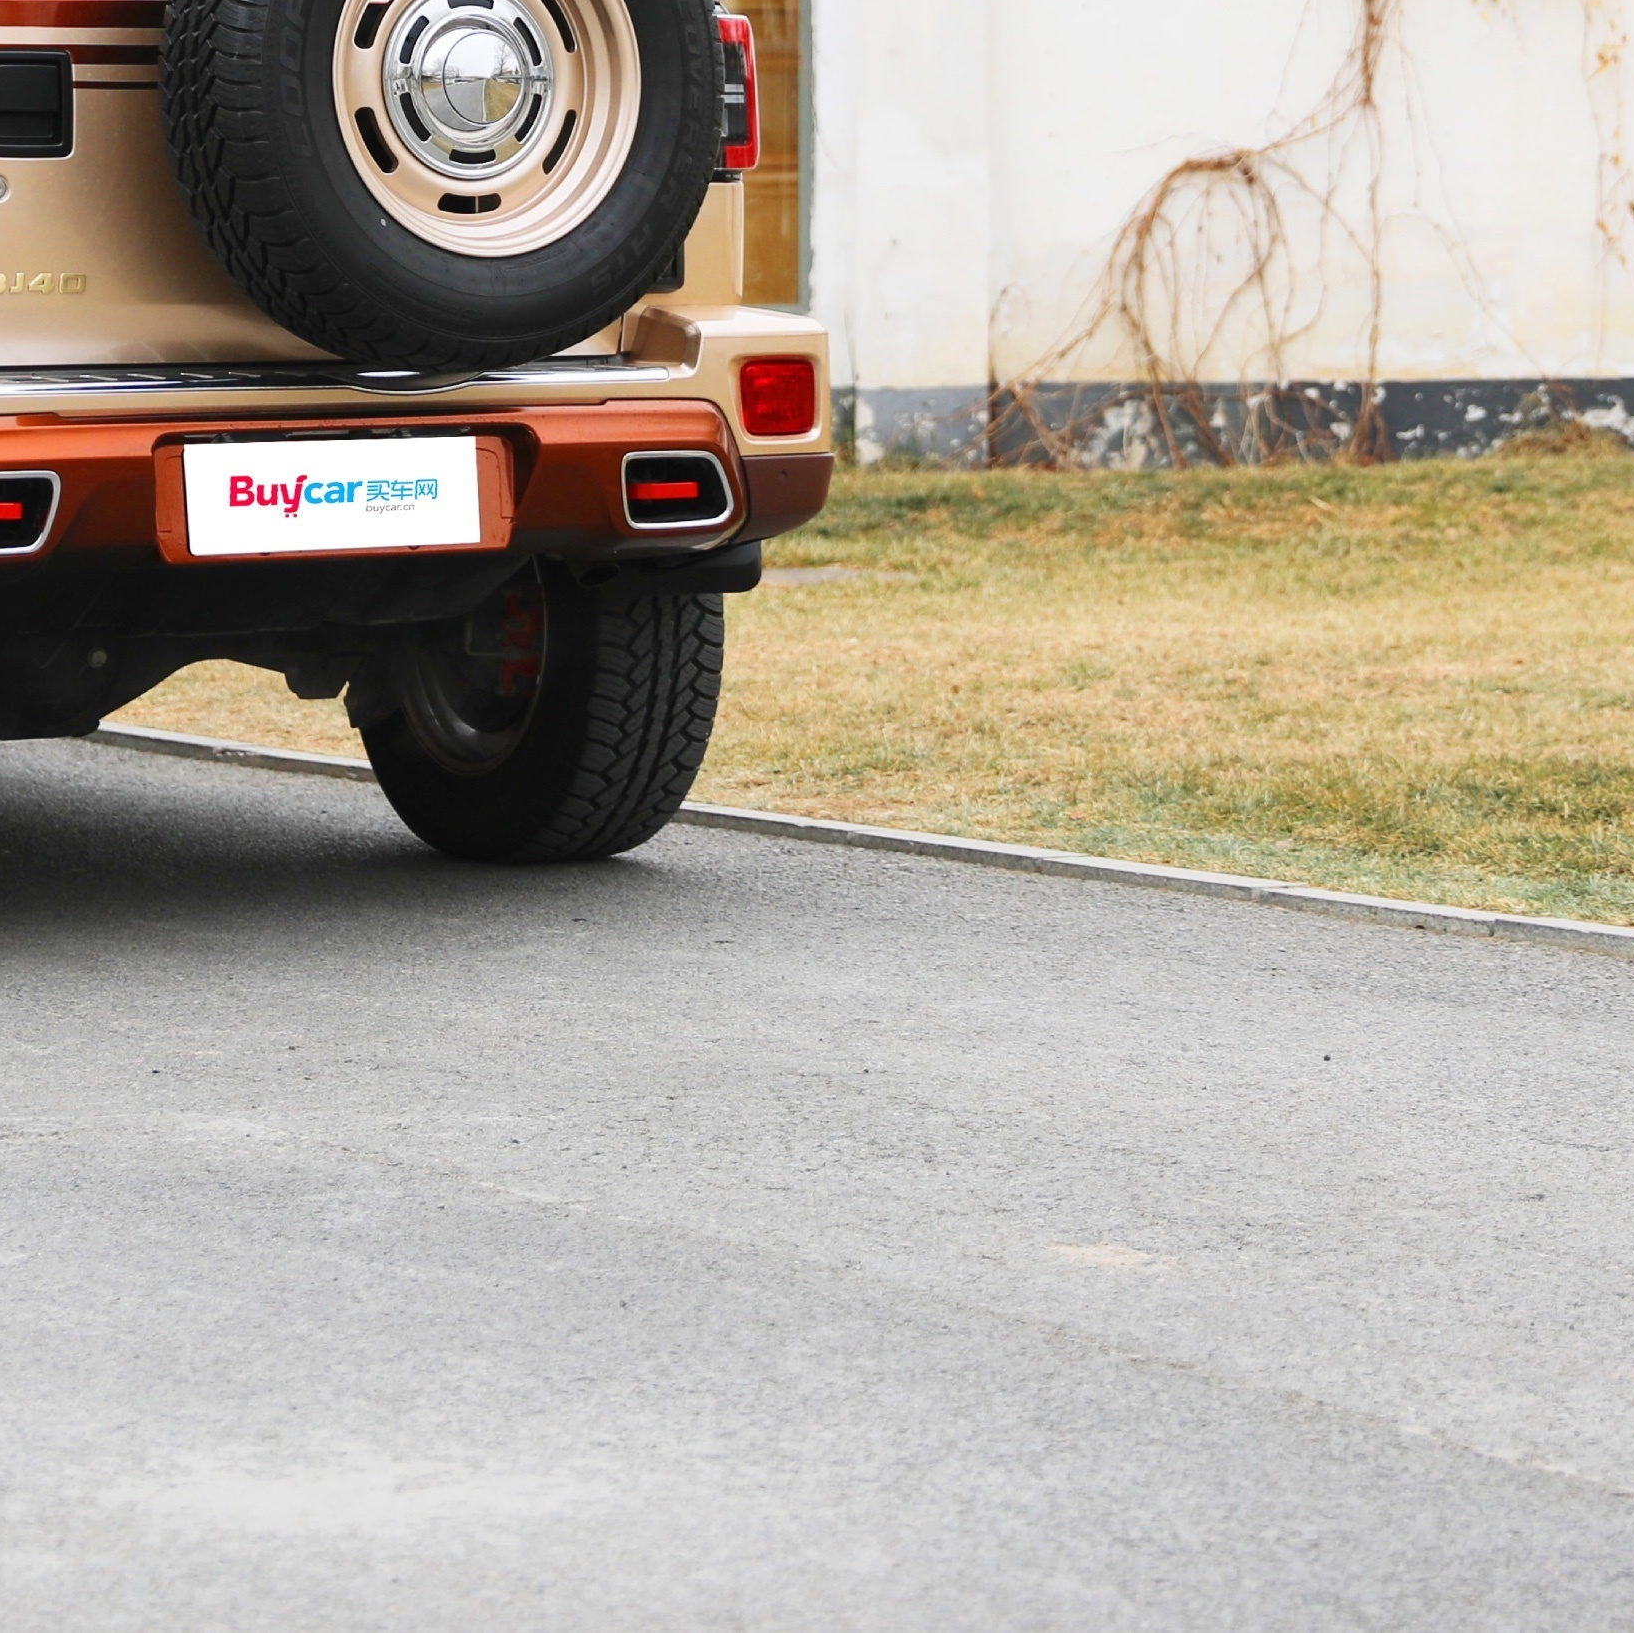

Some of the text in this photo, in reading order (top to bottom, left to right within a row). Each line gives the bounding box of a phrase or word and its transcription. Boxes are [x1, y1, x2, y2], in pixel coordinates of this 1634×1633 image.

[229, 474, 364, 517] Buycar
[366, 478, 438, 502] 买车网
[365, 503, 416, 515] buycar.cn
